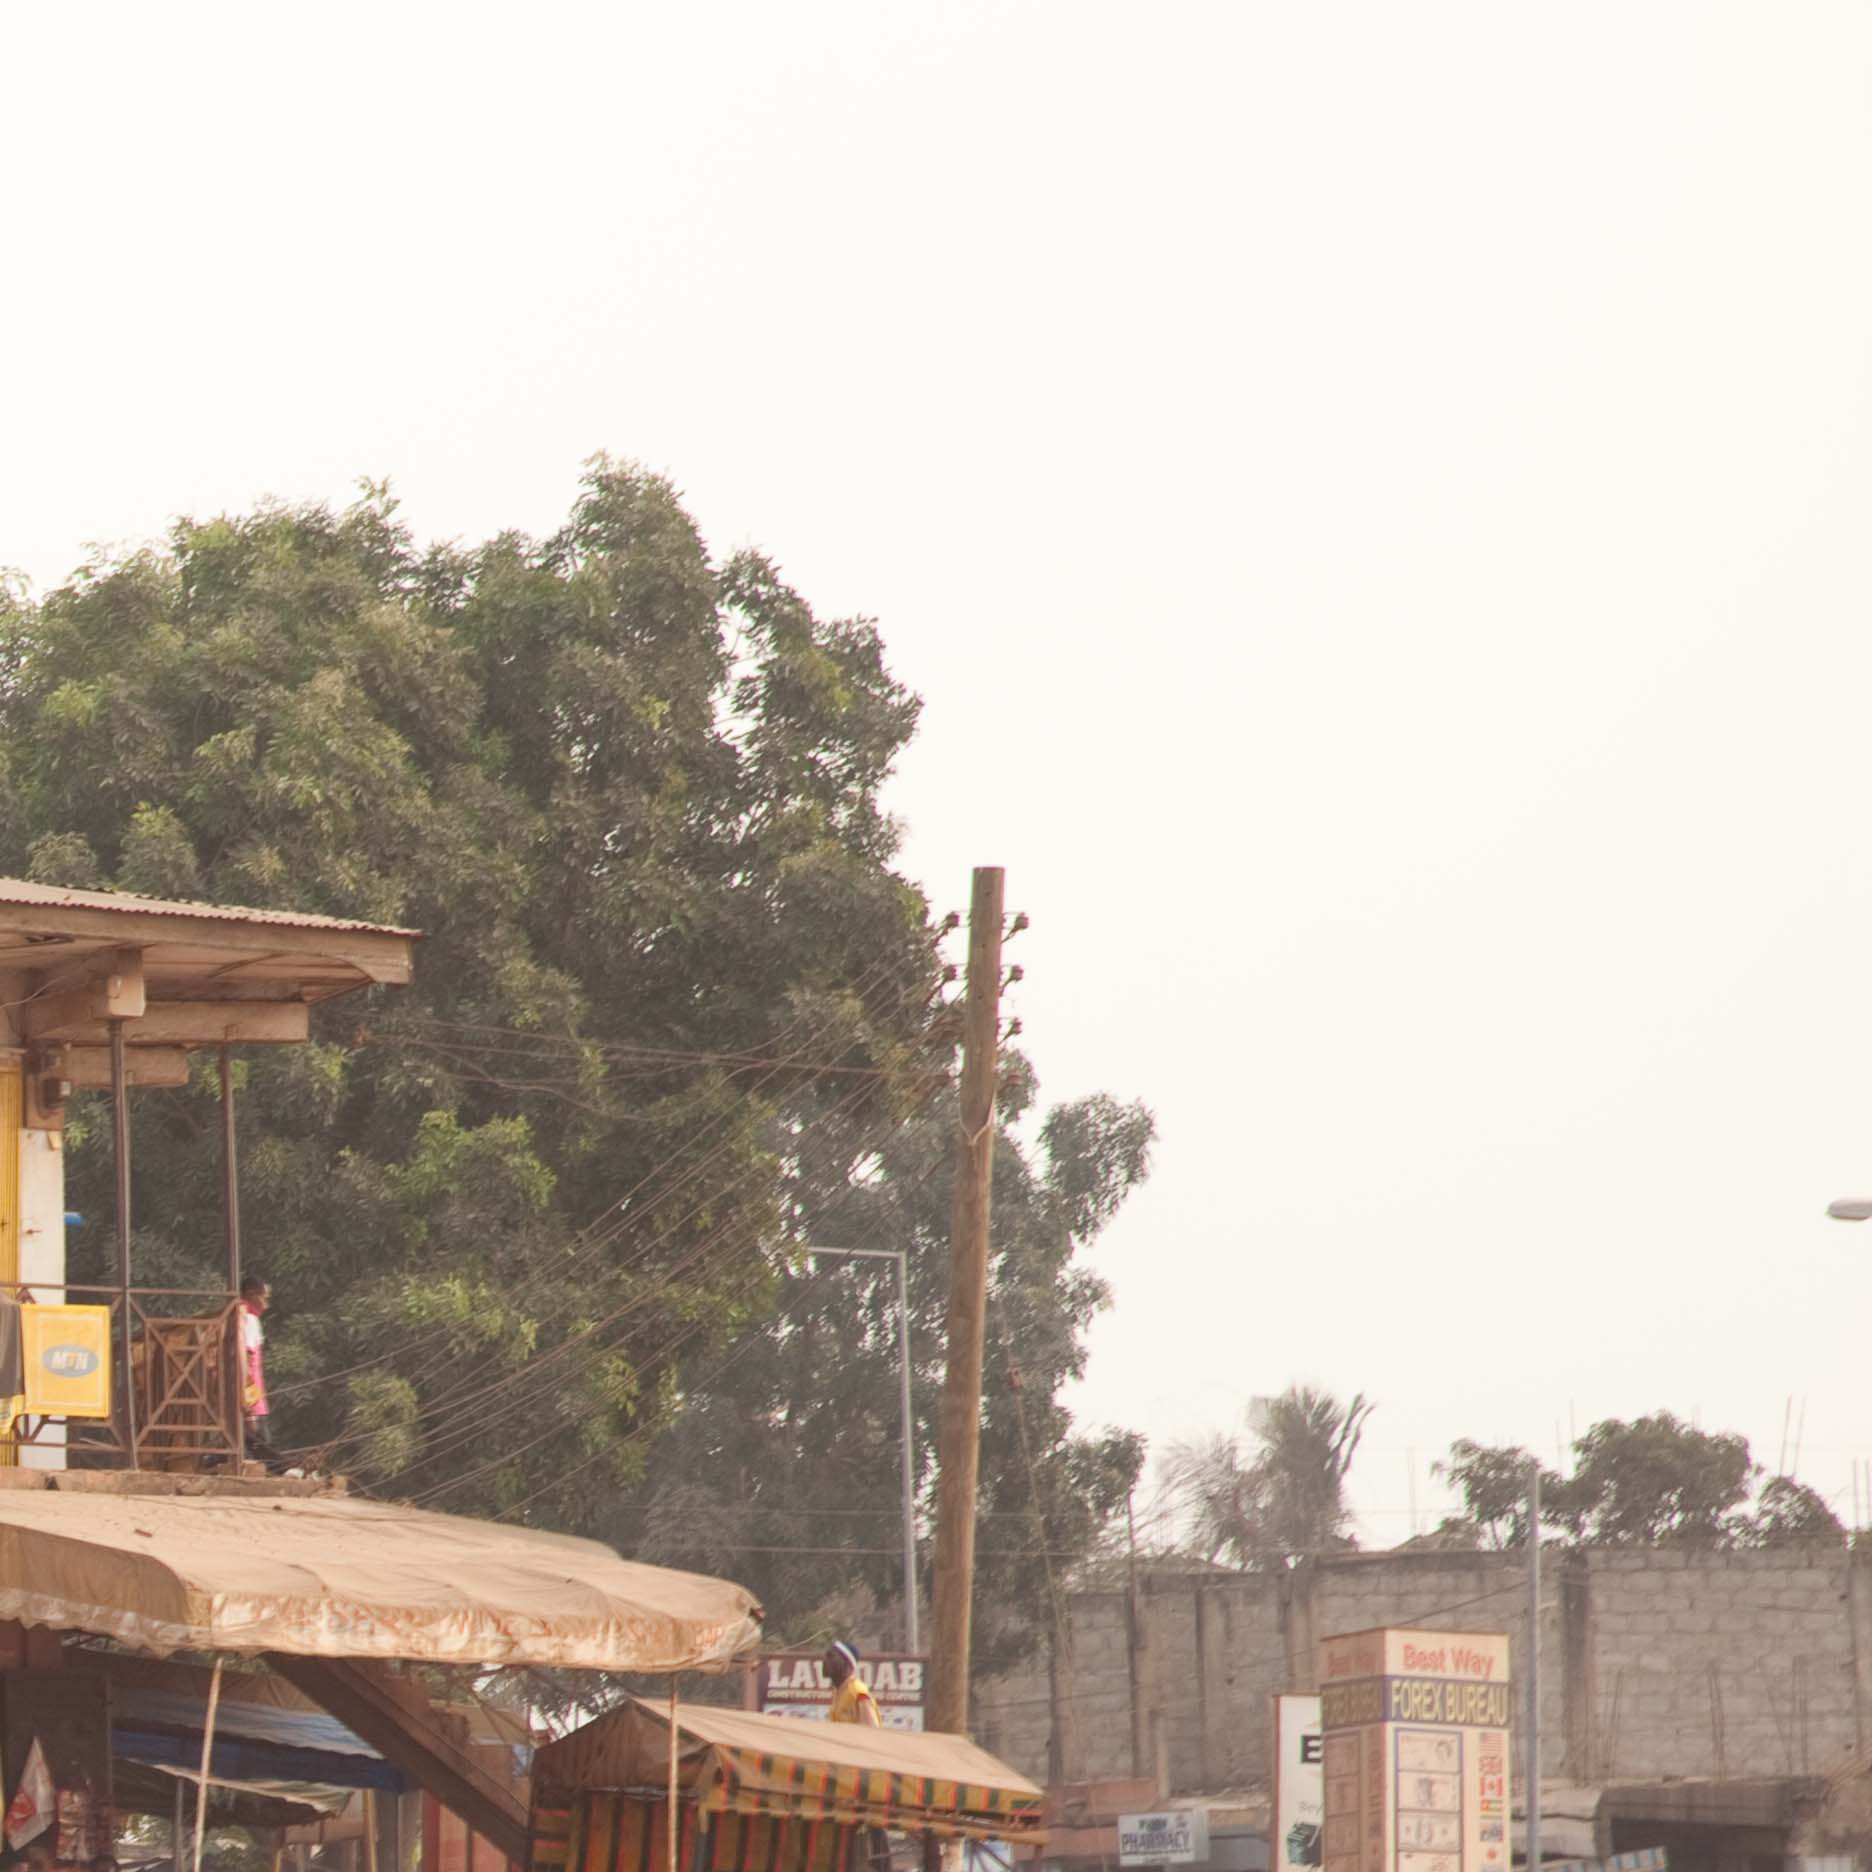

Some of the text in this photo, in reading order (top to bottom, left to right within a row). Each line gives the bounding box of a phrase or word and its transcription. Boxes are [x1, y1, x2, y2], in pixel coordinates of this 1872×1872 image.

[51, 1351, 89, 1371] MTN
[1403, 1643, 1496, 1679] Best Way
[1392, 1680, 1507, 1724] FOREX BUREAU
[1122, 1831, 1190, 1850] PHARMACY
